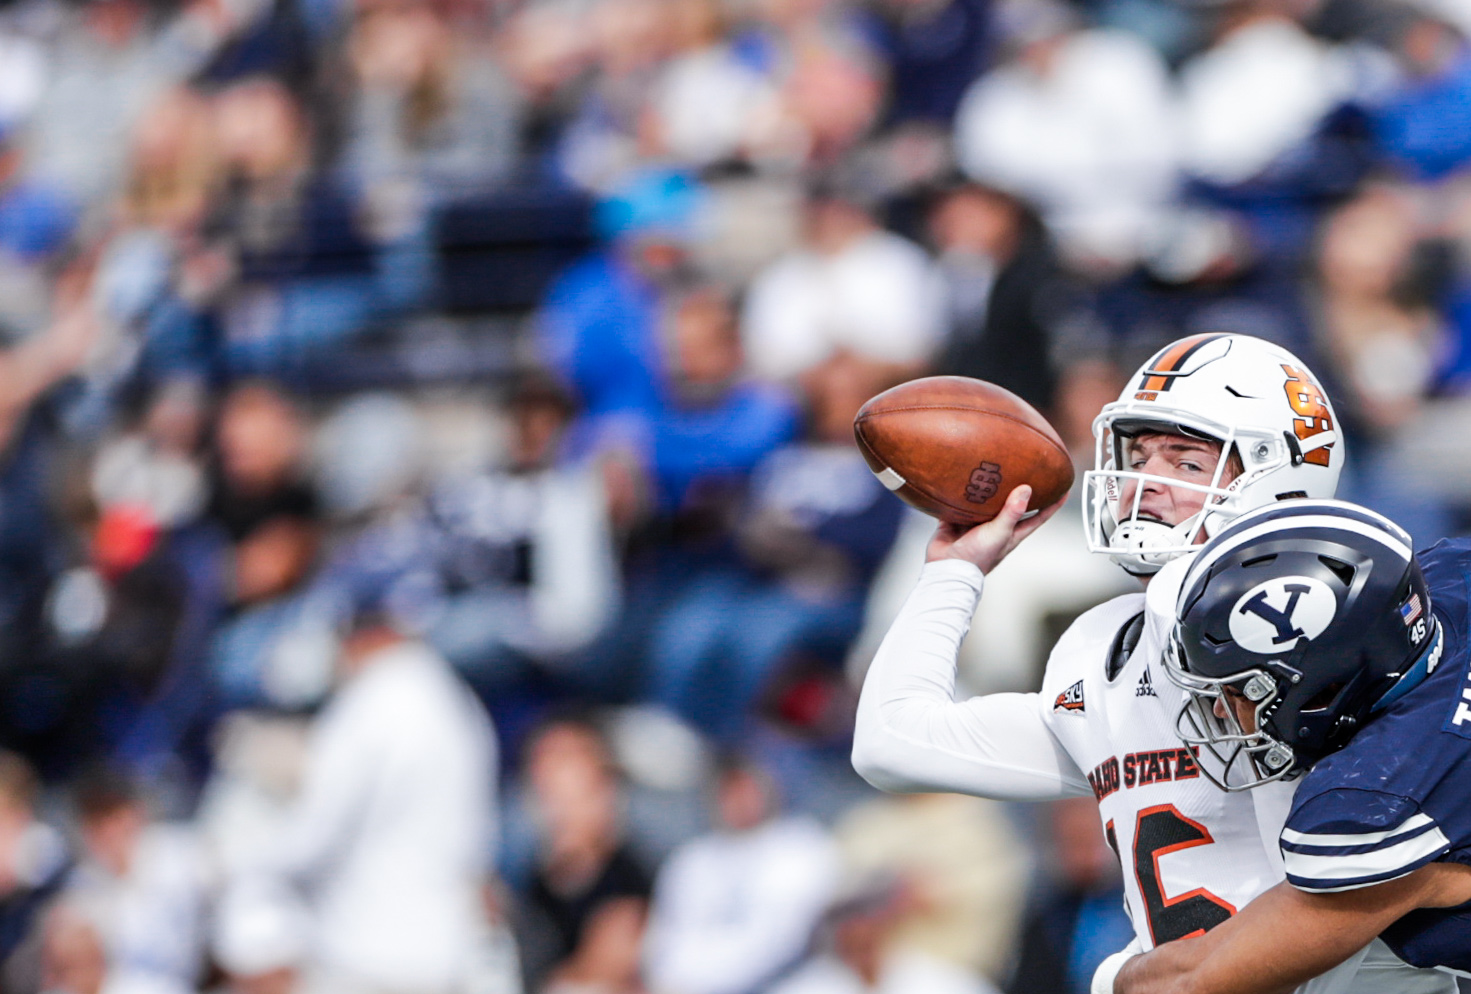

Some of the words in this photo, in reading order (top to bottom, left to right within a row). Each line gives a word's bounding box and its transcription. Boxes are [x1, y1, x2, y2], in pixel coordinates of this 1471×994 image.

[1239, 583, 1312, 645] Y
[1410, 617, 1426, 645] 45
[1123, 745, 1200, 790] STATE
